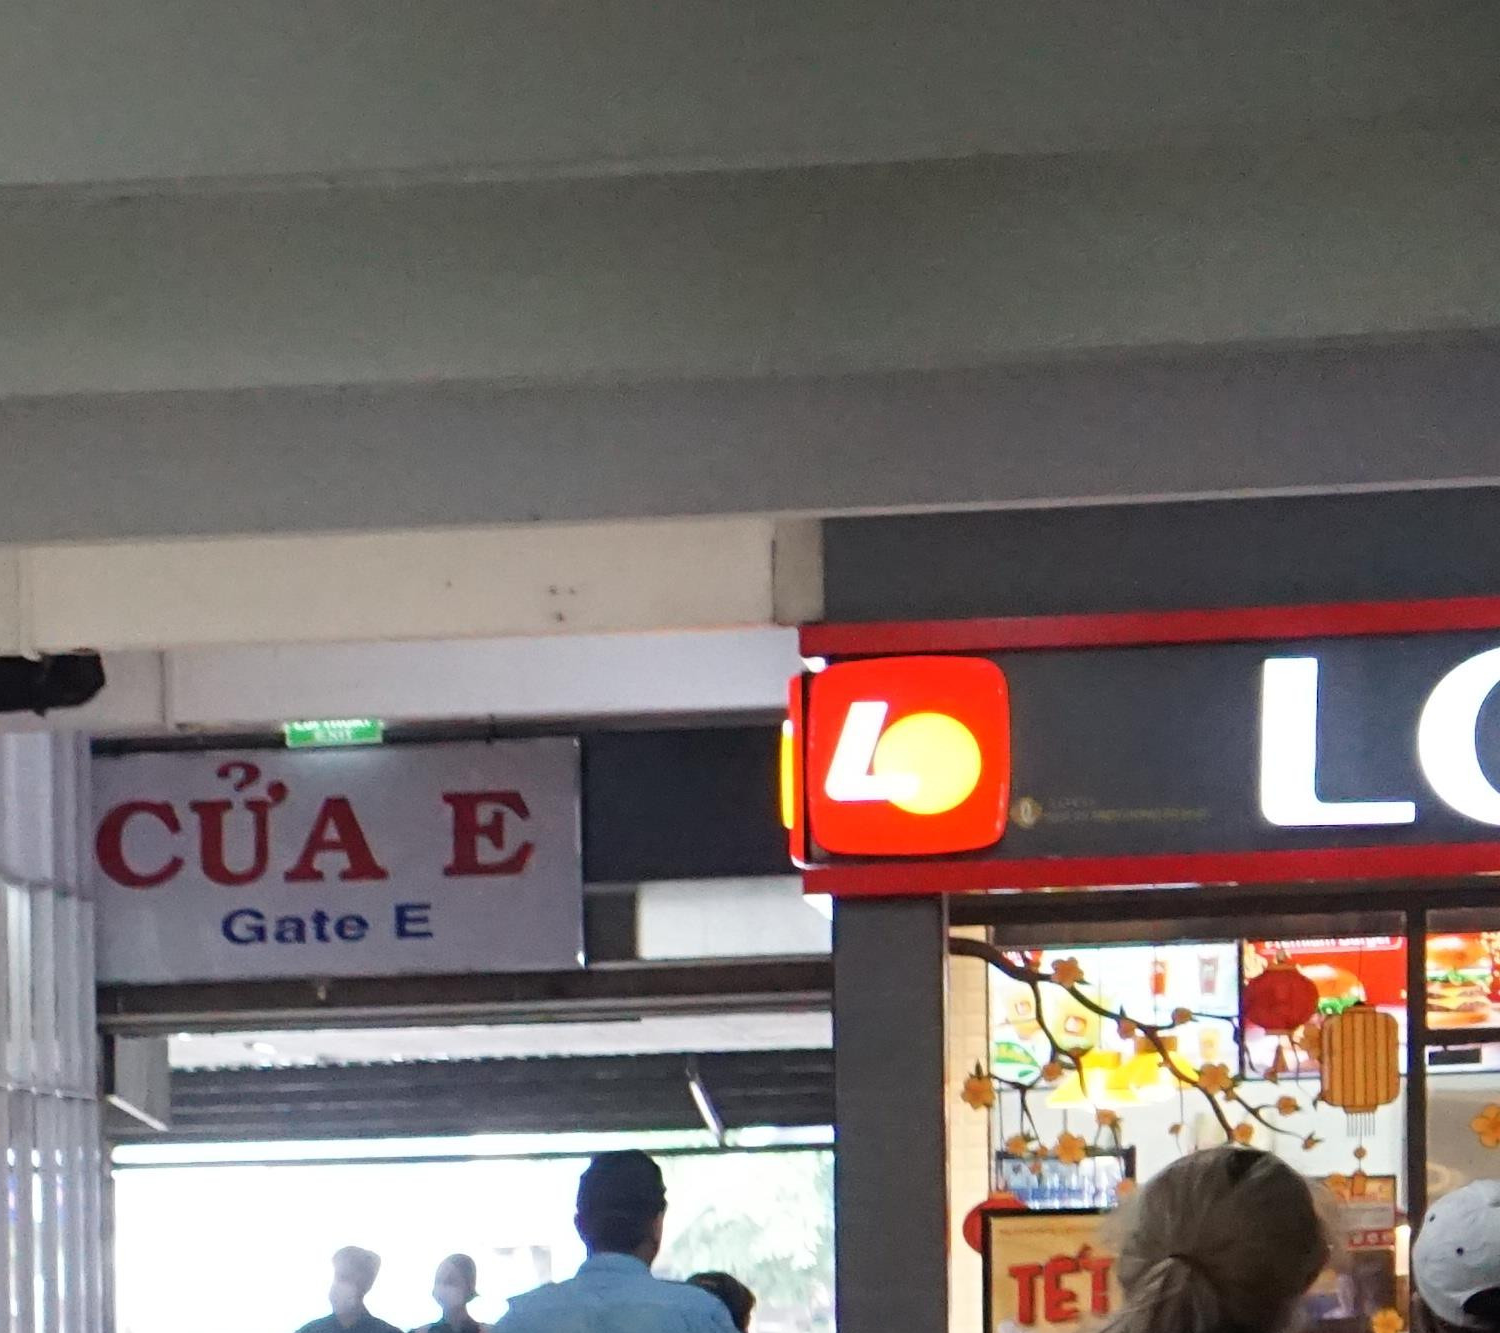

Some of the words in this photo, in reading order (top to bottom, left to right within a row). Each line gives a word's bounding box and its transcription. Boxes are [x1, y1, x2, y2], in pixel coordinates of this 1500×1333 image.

[93, 761, 389, 889] CỬA
[442, 790, 534, 878] E
[222, 907, 370, 945] Gate
[394, 903, 433, 940] E
